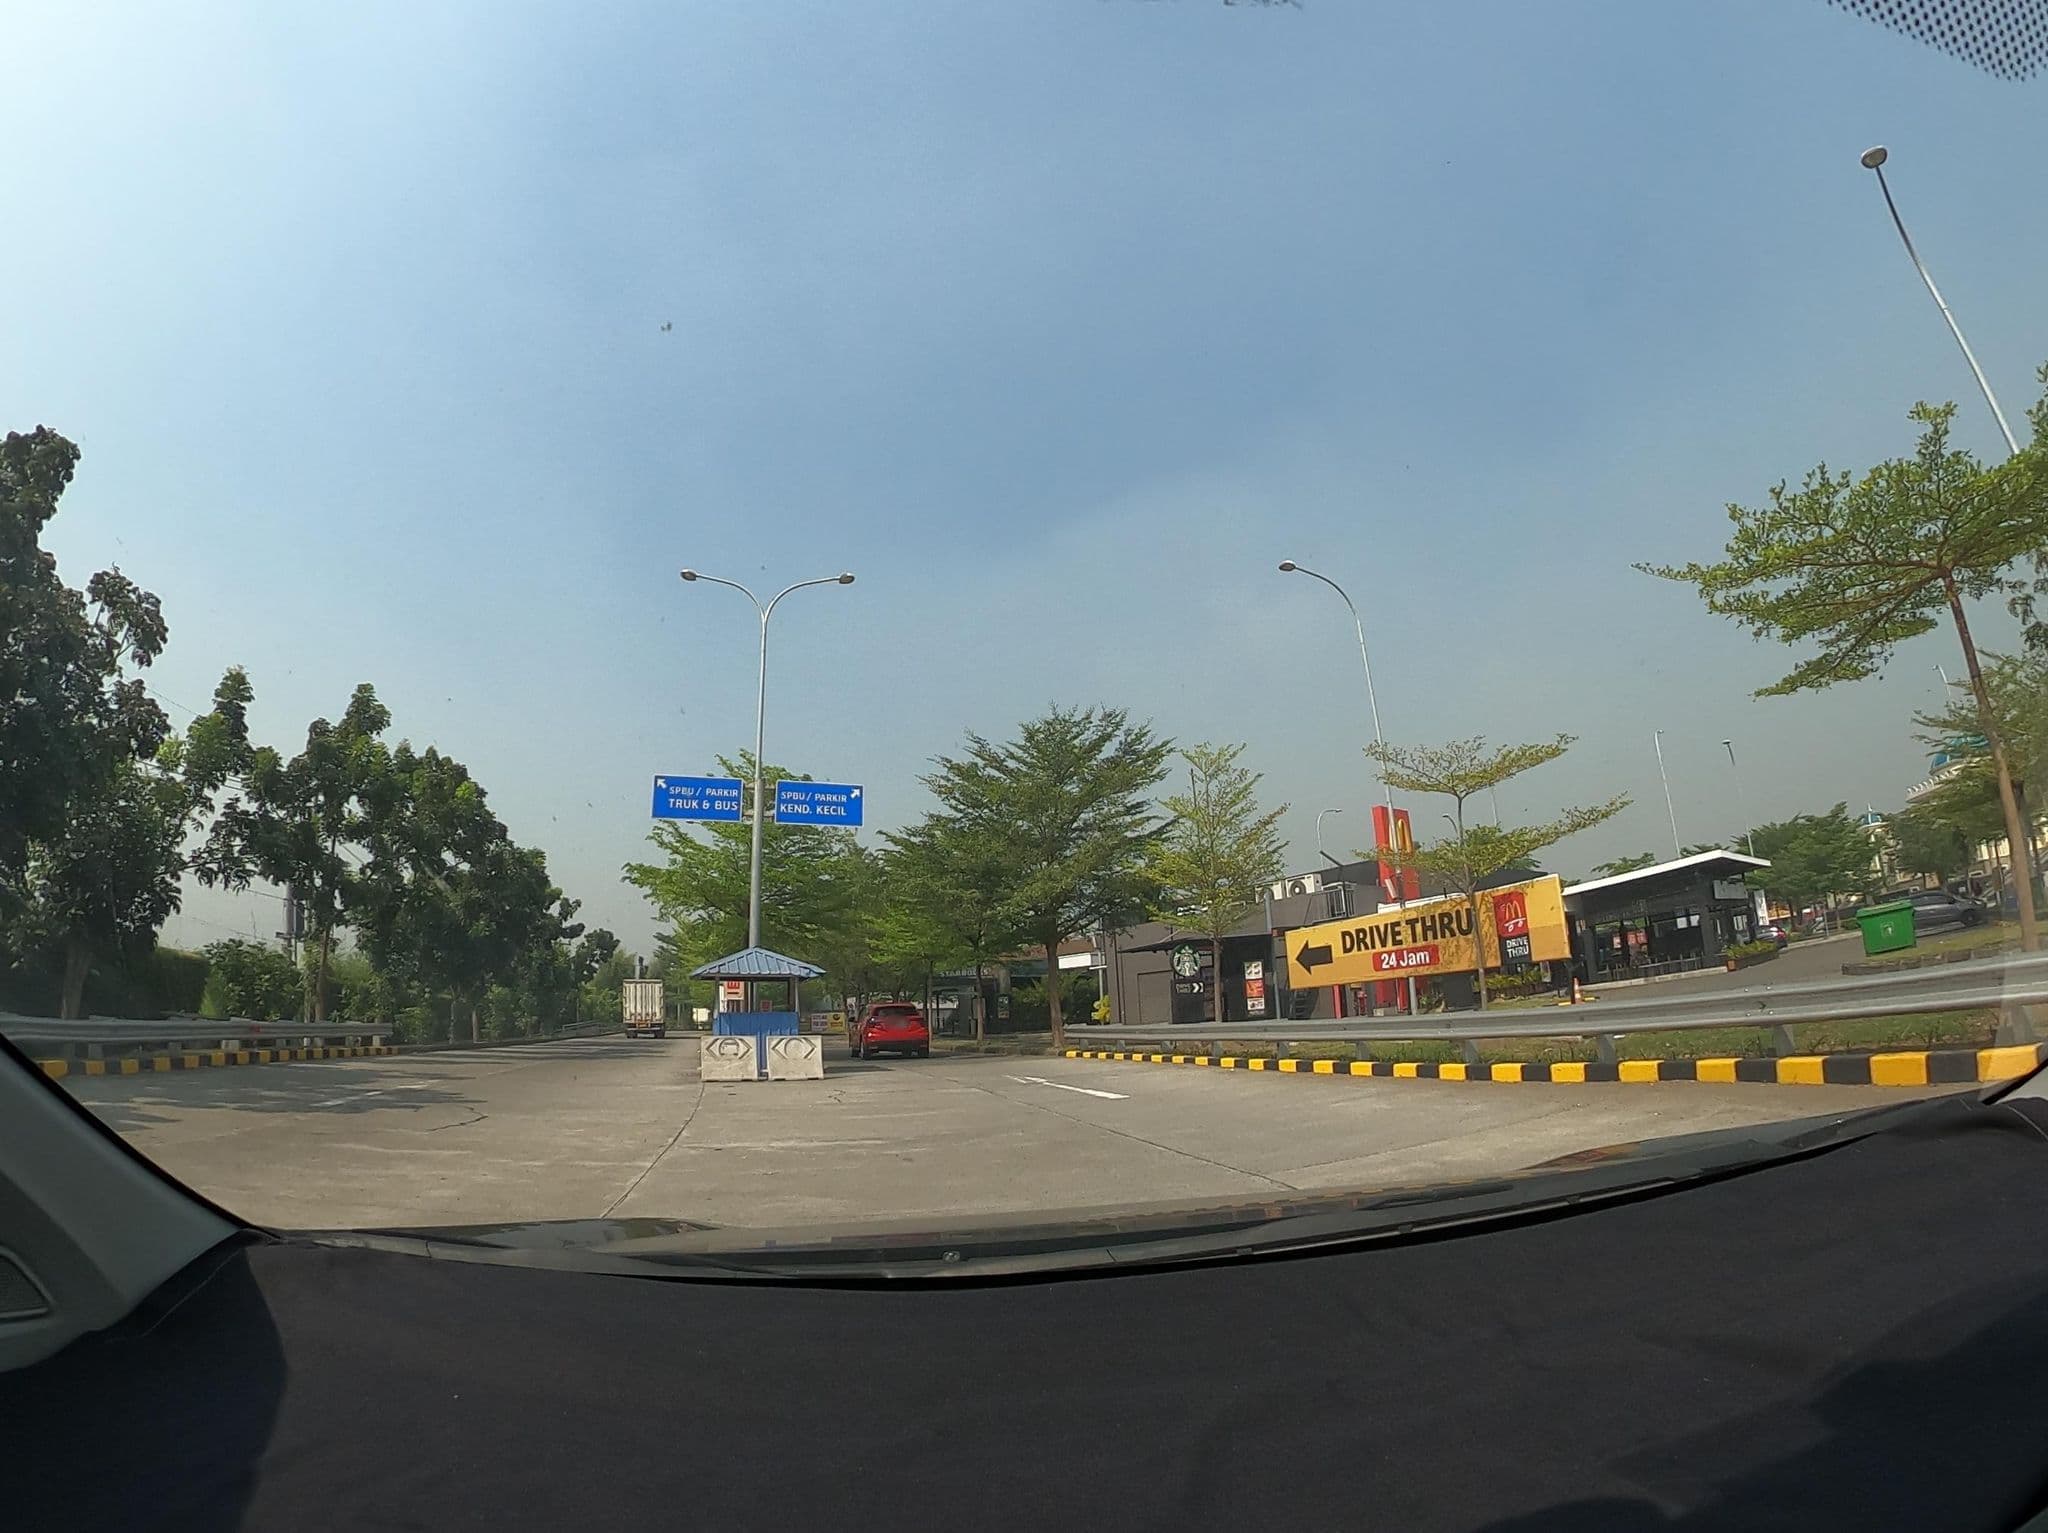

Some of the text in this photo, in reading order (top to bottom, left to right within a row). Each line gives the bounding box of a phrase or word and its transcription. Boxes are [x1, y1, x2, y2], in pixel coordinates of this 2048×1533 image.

[705, 788, 739, 798] PARKIR
[814, 792, 848, 803] PARKIR
[668, 798, 739, 812] TRUK & BUS
[779, 804, 848, 817] KEND. KECIL
[1341, 907, 1475, 954] DRIVE THRU
[1506, 936, 1529, 949] DRIVE
[1380, 949, 1431, 969] 24 Jam
[1507, 946, 1530, 959] THRU
